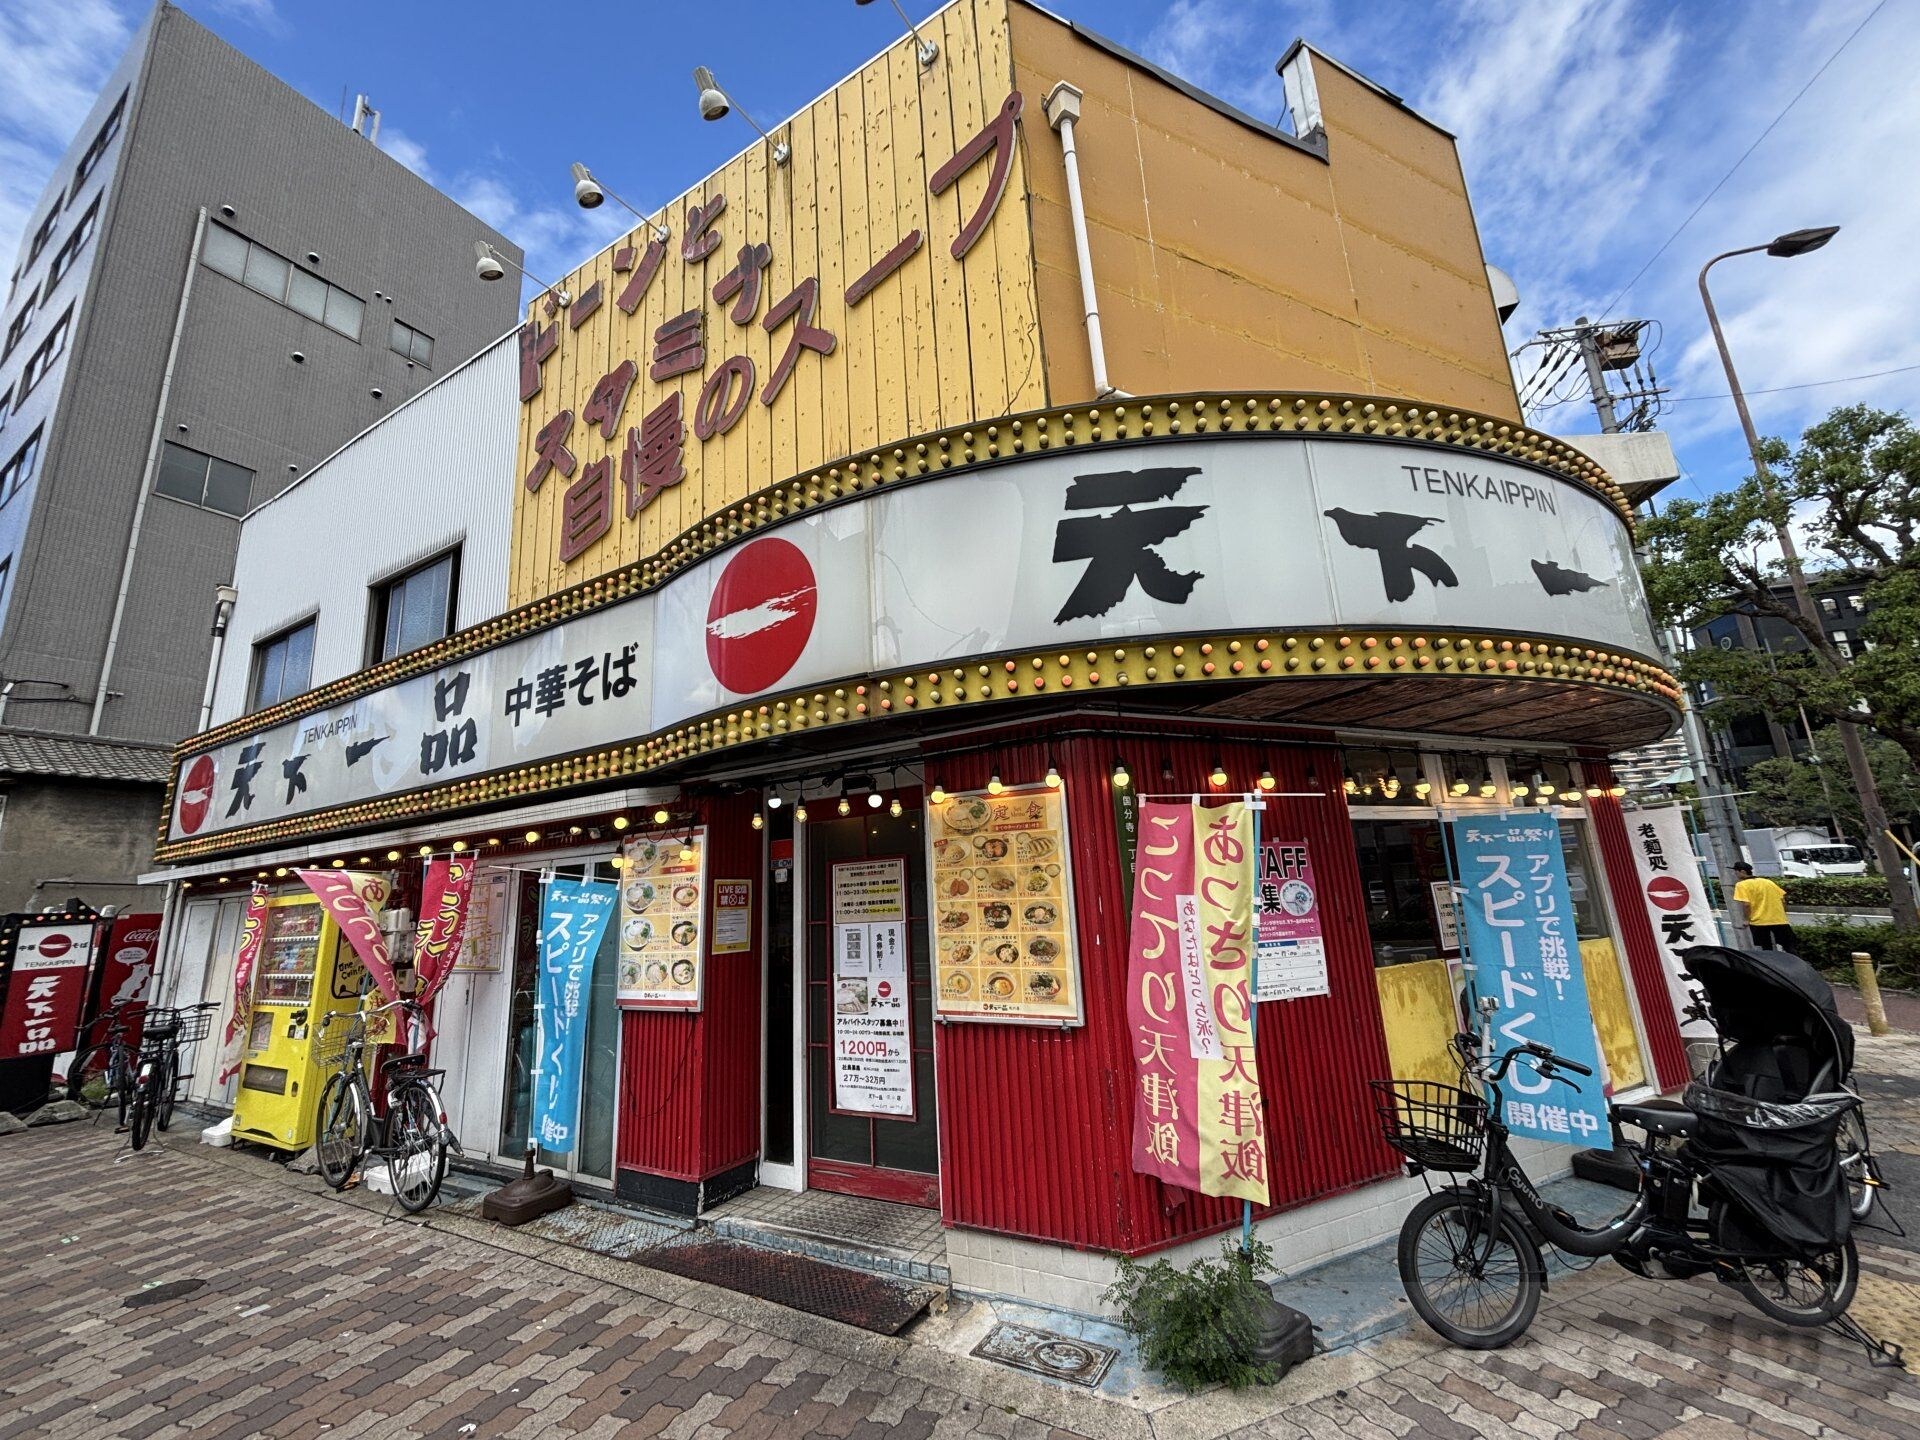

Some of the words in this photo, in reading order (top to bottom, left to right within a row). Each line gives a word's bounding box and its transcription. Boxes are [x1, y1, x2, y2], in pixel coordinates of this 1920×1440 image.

[559, 91, 1024, 564] 自慢のスープ
[526, 242, 772, 493] スタミナ
[1401, 464, 1558, 517] TENKAIPPIN
[504, 642, 640, 728] 中華そば
[225, 671, 478, 819] 天下一品
[302, 713, 359, 746] TENKAIPPIN
[1465, 828, 1554, 843] 天下一品祭り
[1260, 847, 1308, 880] AFF
[550, 889, 613, 906] 天下一品祭り
[718, 885, 734, 894] LIVE
[1260, 884, 1282, 914] 集
[24, 959, 77, 967] TENKAIPPIN
[1477, 855, 1552, 1095] スピードくじ
[19, 975, 62, 1054] 天下一品
[870, 997, 901, 1008] 天下一品
[840, 1039, 900, 1057] 1200円から
[1507, 1100, 1598, 1137] 開催中
